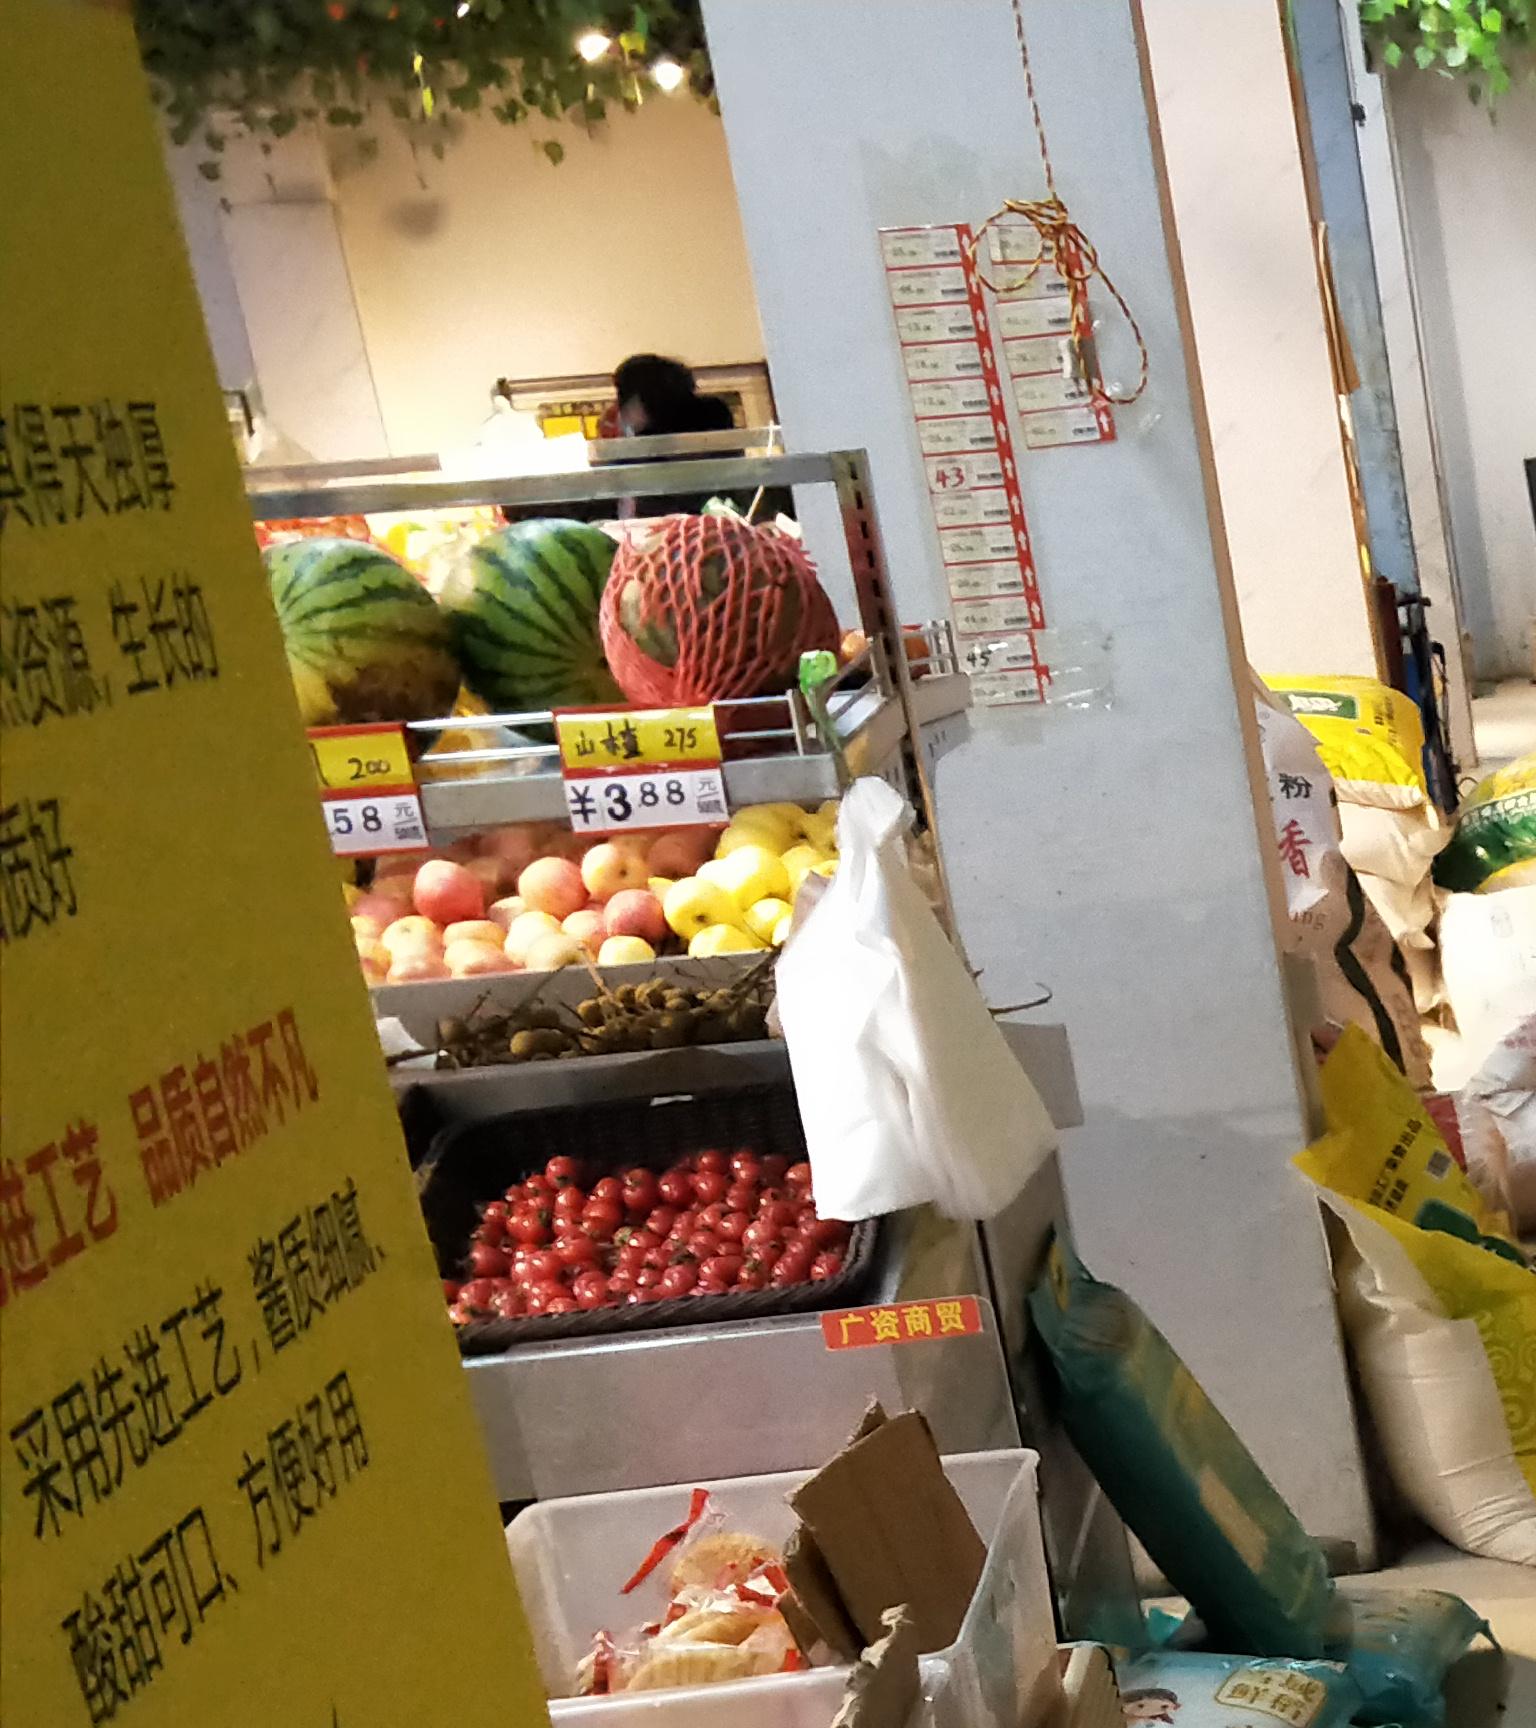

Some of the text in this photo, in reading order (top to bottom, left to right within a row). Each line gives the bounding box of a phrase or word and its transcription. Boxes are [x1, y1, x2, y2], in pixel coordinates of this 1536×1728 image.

[934, 467, 966, 488] 43
[111, 578, 219, 697] 生长的
[575, 718, 697, 758] 山楂 275
[0, 1006, 321, 1307] 进工艺 品质自然不凡
[838, 1299, 965, 1344] 广资商贸
